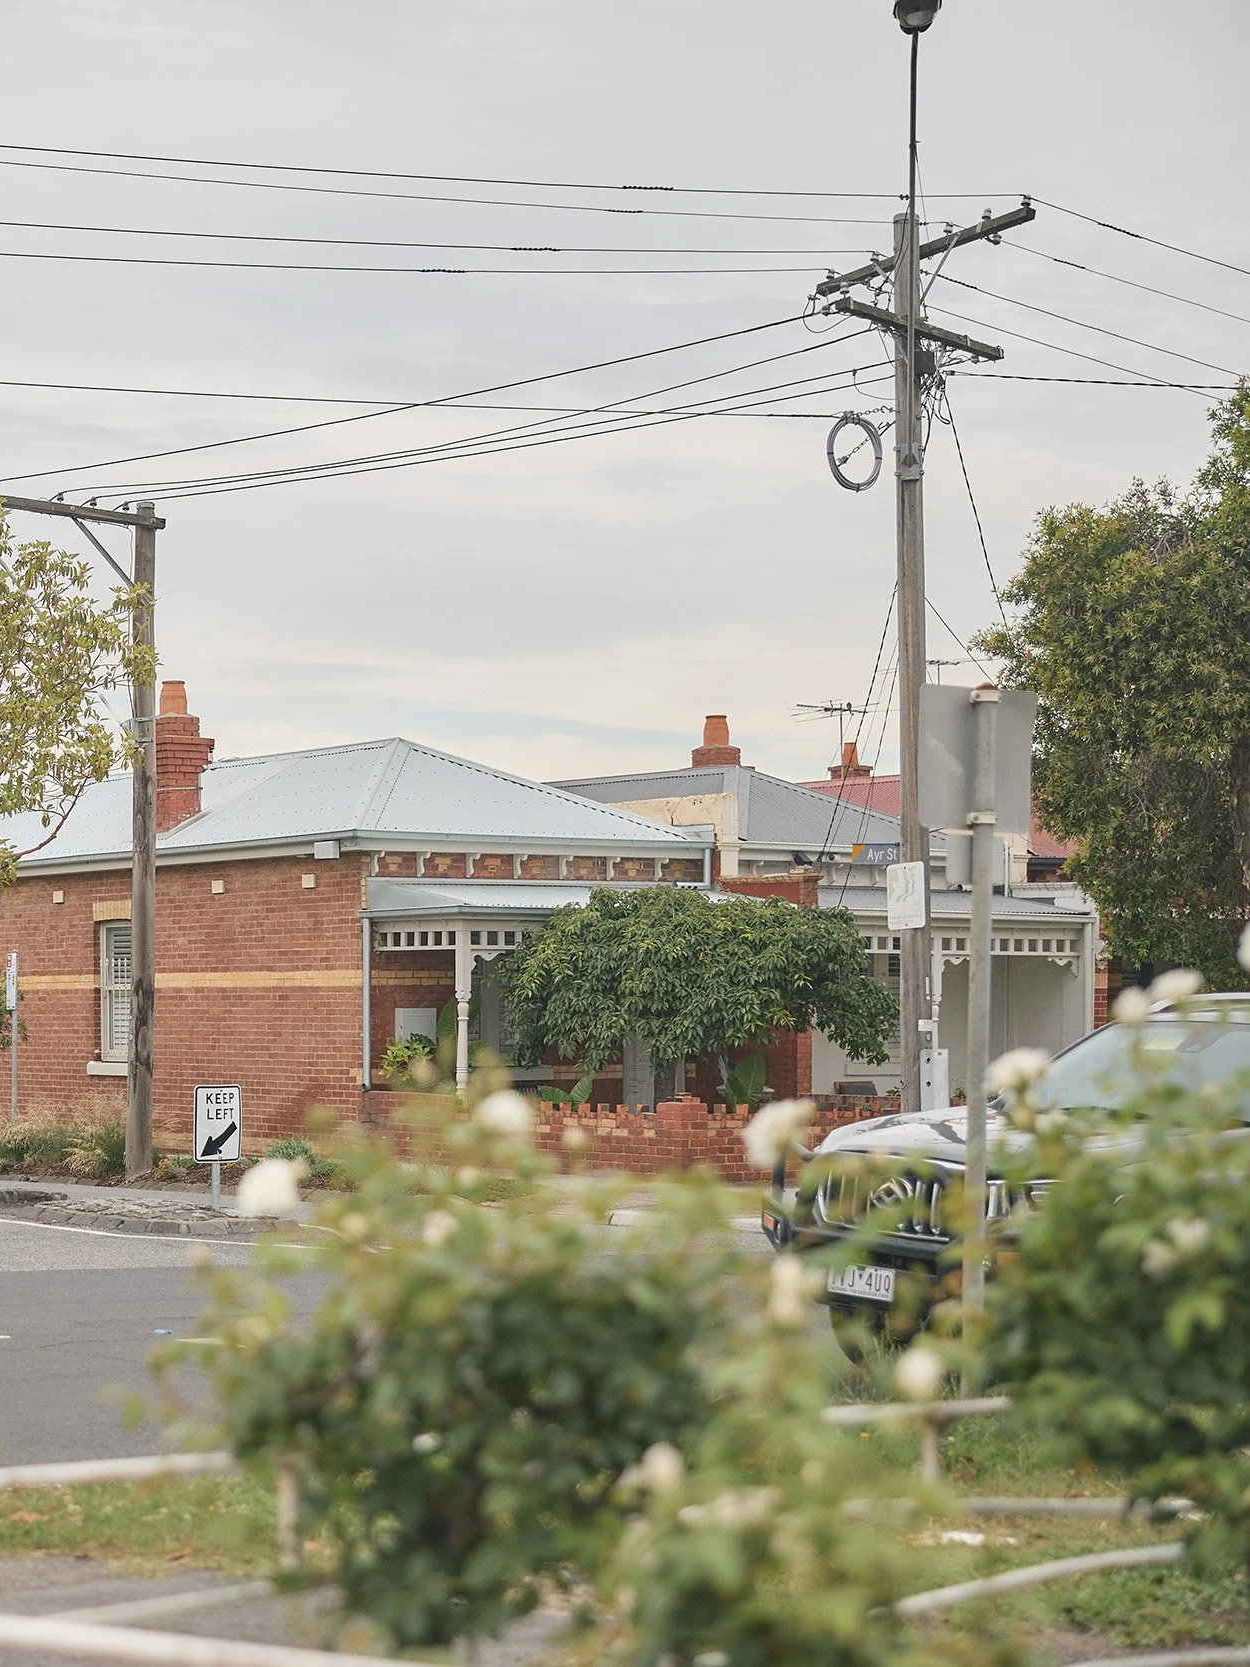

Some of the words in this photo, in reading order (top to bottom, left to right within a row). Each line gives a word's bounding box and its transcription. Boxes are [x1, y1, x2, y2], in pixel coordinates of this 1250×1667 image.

[867, 848, 884, 864] Ayr
[886, 848, 898, 861] St
[206, 1092, 235, 1105] KEEP
[207, 1108, 234, 1120] LEFT
